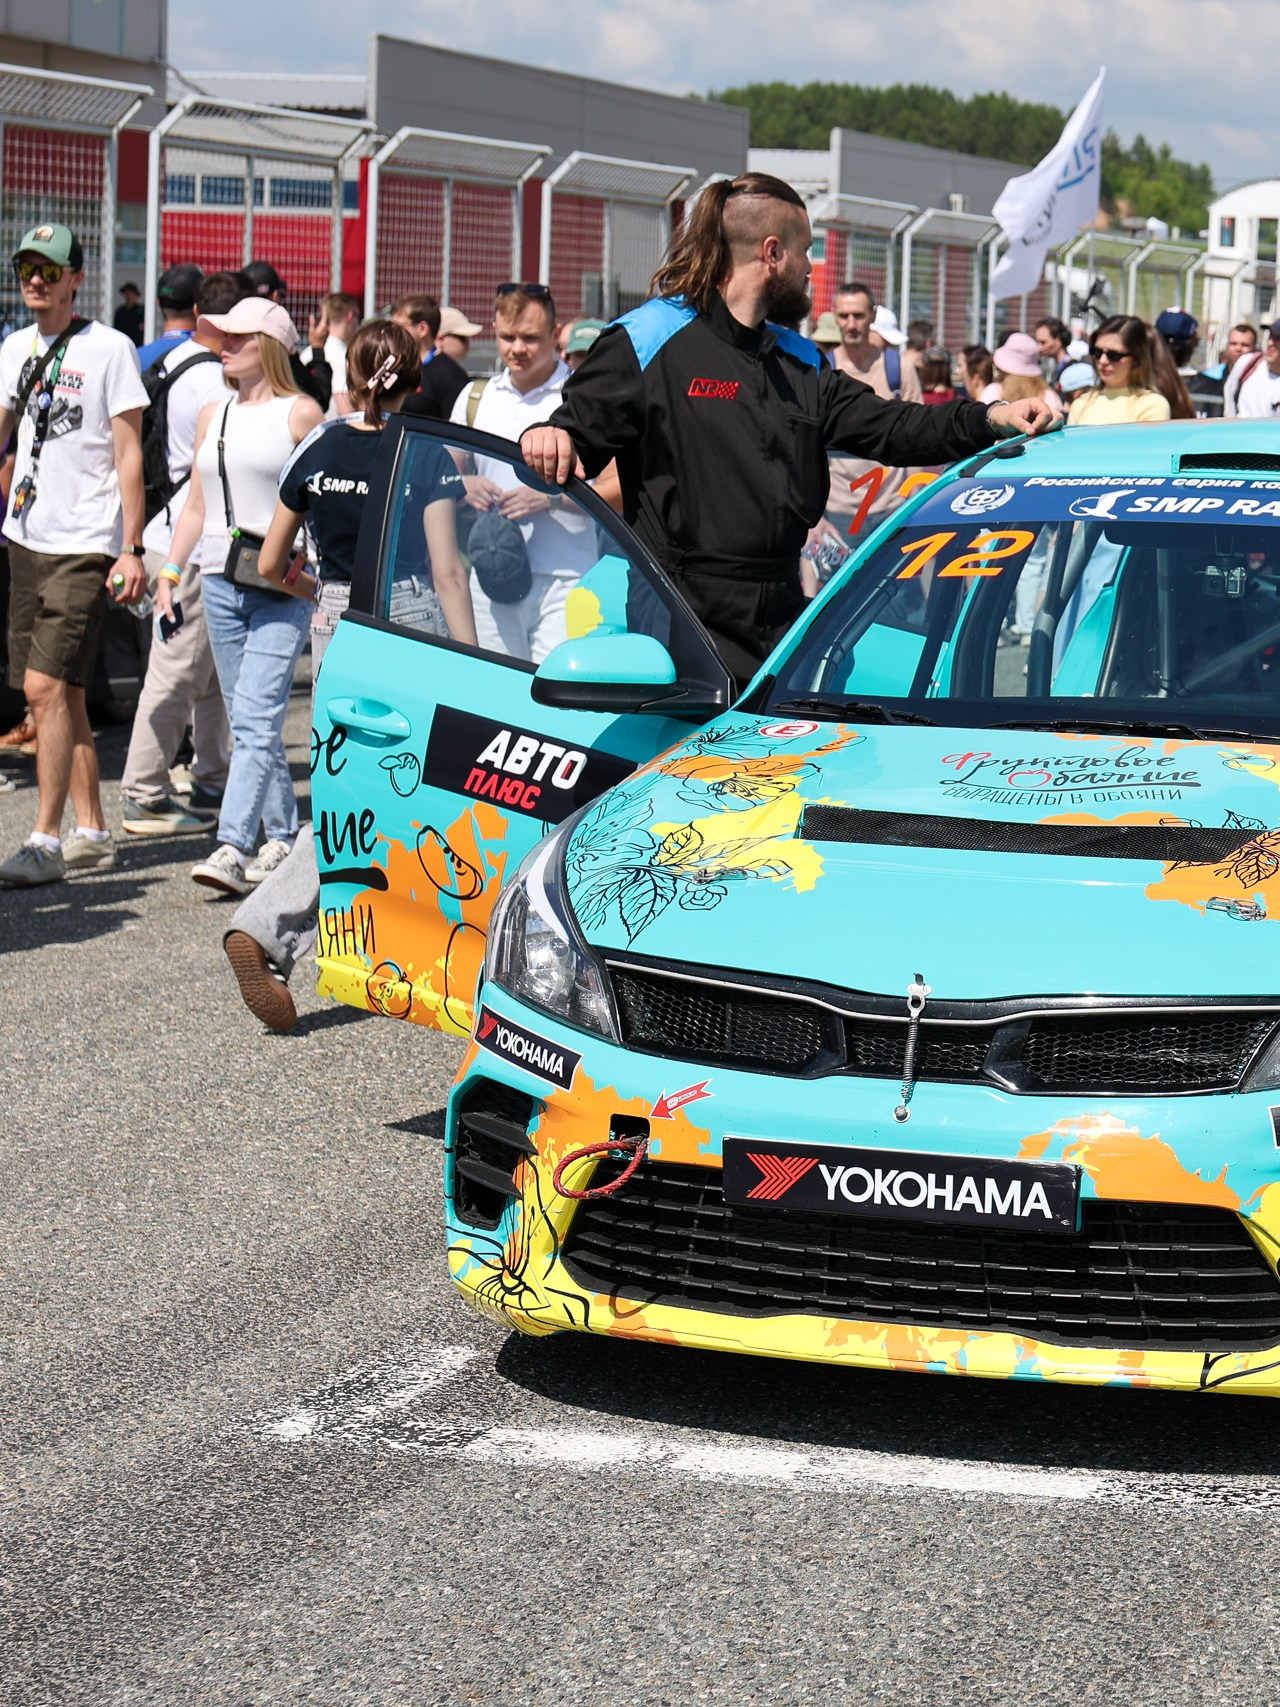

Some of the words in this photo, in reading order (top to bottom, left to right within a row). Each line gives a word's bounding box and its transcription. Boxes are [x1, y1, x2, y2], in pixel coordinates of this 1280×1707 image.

[322, 477, 354, 494] SMP
[1023, 476, 1164, 488] Российская
[1171, 477, 1245, 489] серия
[1126, 497, 1224, 514] SMP
[896, 530, 1035, 580] 12
[774, 725, 805, 735] E
[476, 729, 588, 790] АВТО
[939, 746, 1176, 785] Фруктовое
[463, 767, 542, 810] ПЛЮС
[942, 786, 1062, 806] ВЫРАЩЕНЫ
[317, 903, 377, 957] ЯНИ
[495, 1024, 564, 1078] YOKOHAMA
[818, 1164, 1053, 1219] YOKOHAMA
